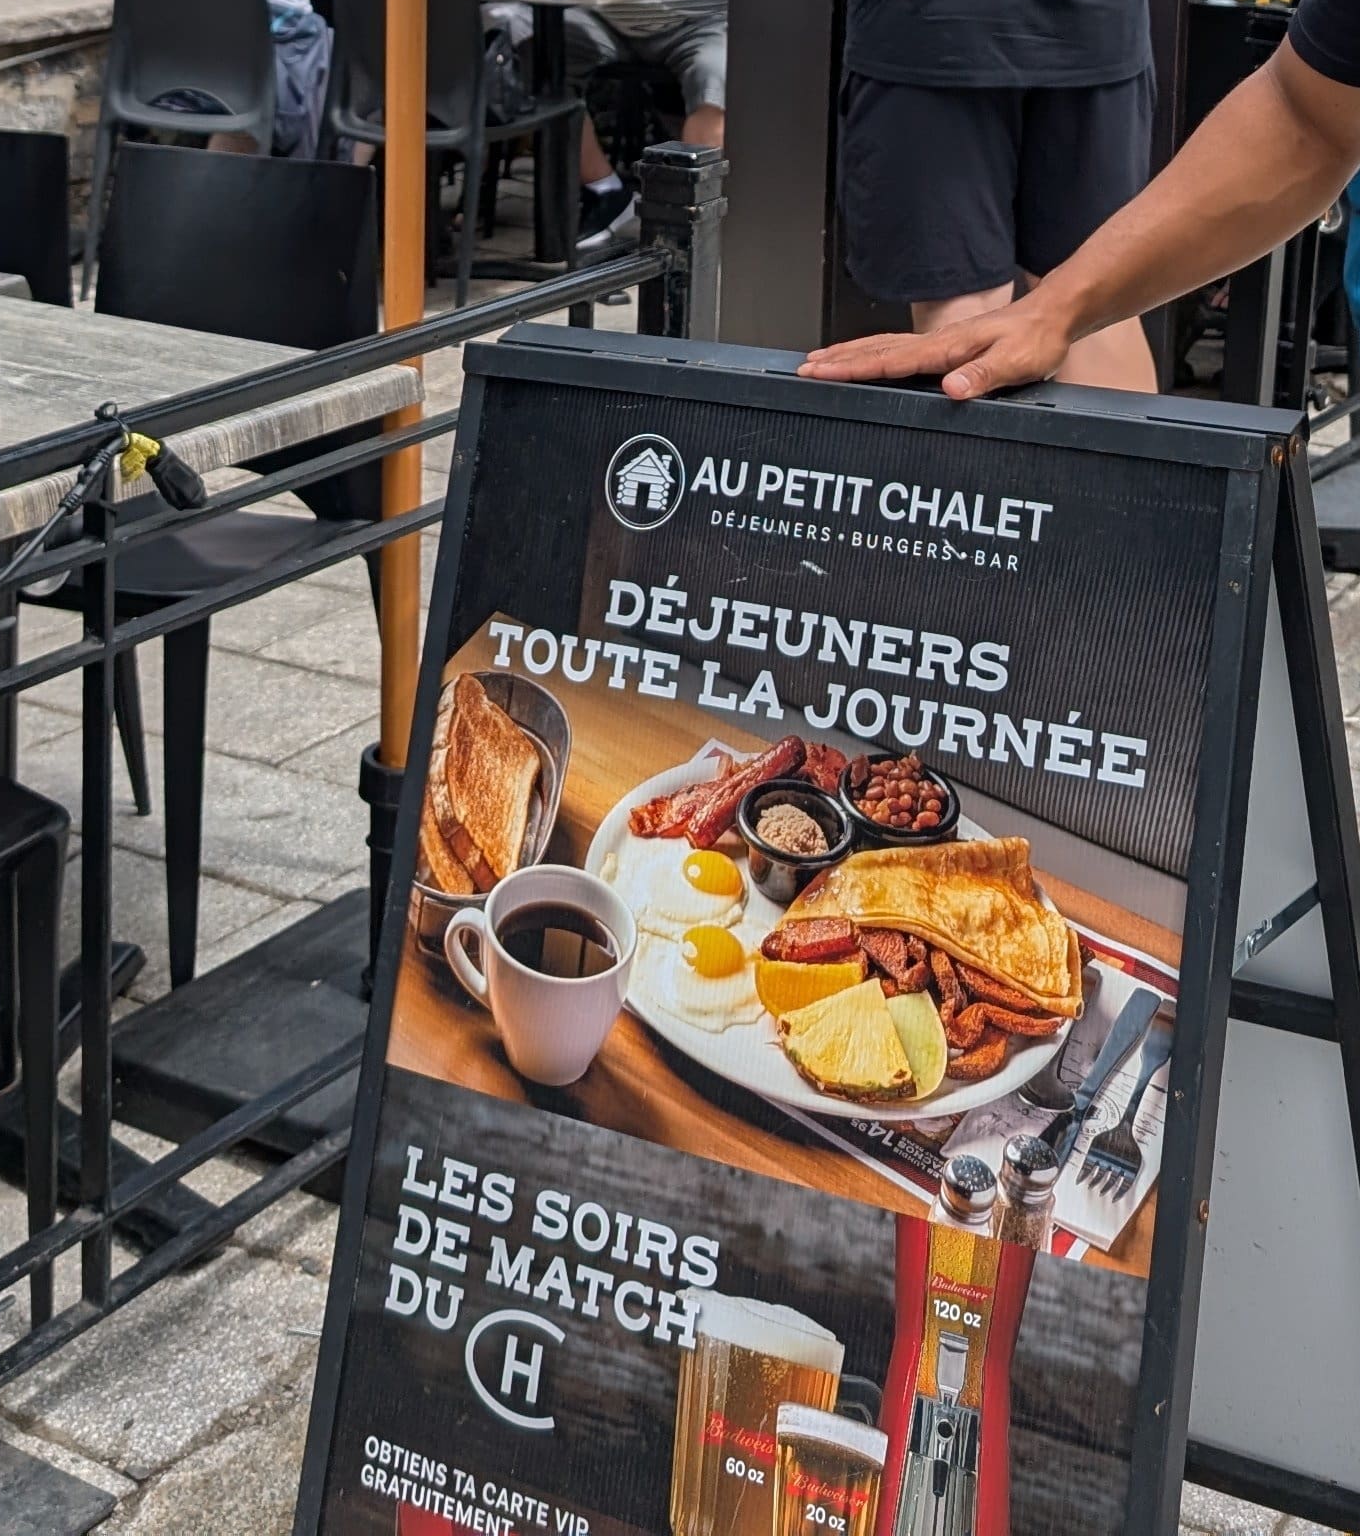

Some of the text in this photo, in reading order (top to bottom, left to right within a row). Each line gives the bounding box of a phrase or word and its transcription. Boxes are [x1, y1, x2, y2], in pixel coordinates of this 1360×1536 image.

[690, 456, 1054, 543] AU PETIT CHALET
[710, 508, 1020, 572] DÉJEUNERS BURGERS BAR
[604, 574, 1011, 694] DÉJEUNERS
[488, 620, 1149, 789] TOUTE LA JOURNÉE
[401, 1144, 721, 1289] LES SOIRS
[384, 1262, 465, 1331] DU
[392, 1204, 702, 1352] DE MATCH
[930, 1275, 989, 1302] Budweiser
[933, 1298, 983, 1329] 120 oz
[360, 1463, 516, 1536] GRATUITEMENT
[363, 1435, 591, 1536] OBTIENS TA CARTE VIP
[725, 1456, 766, 1485] 60 oz
[805, 1503, 847, 1532] 20 oz
